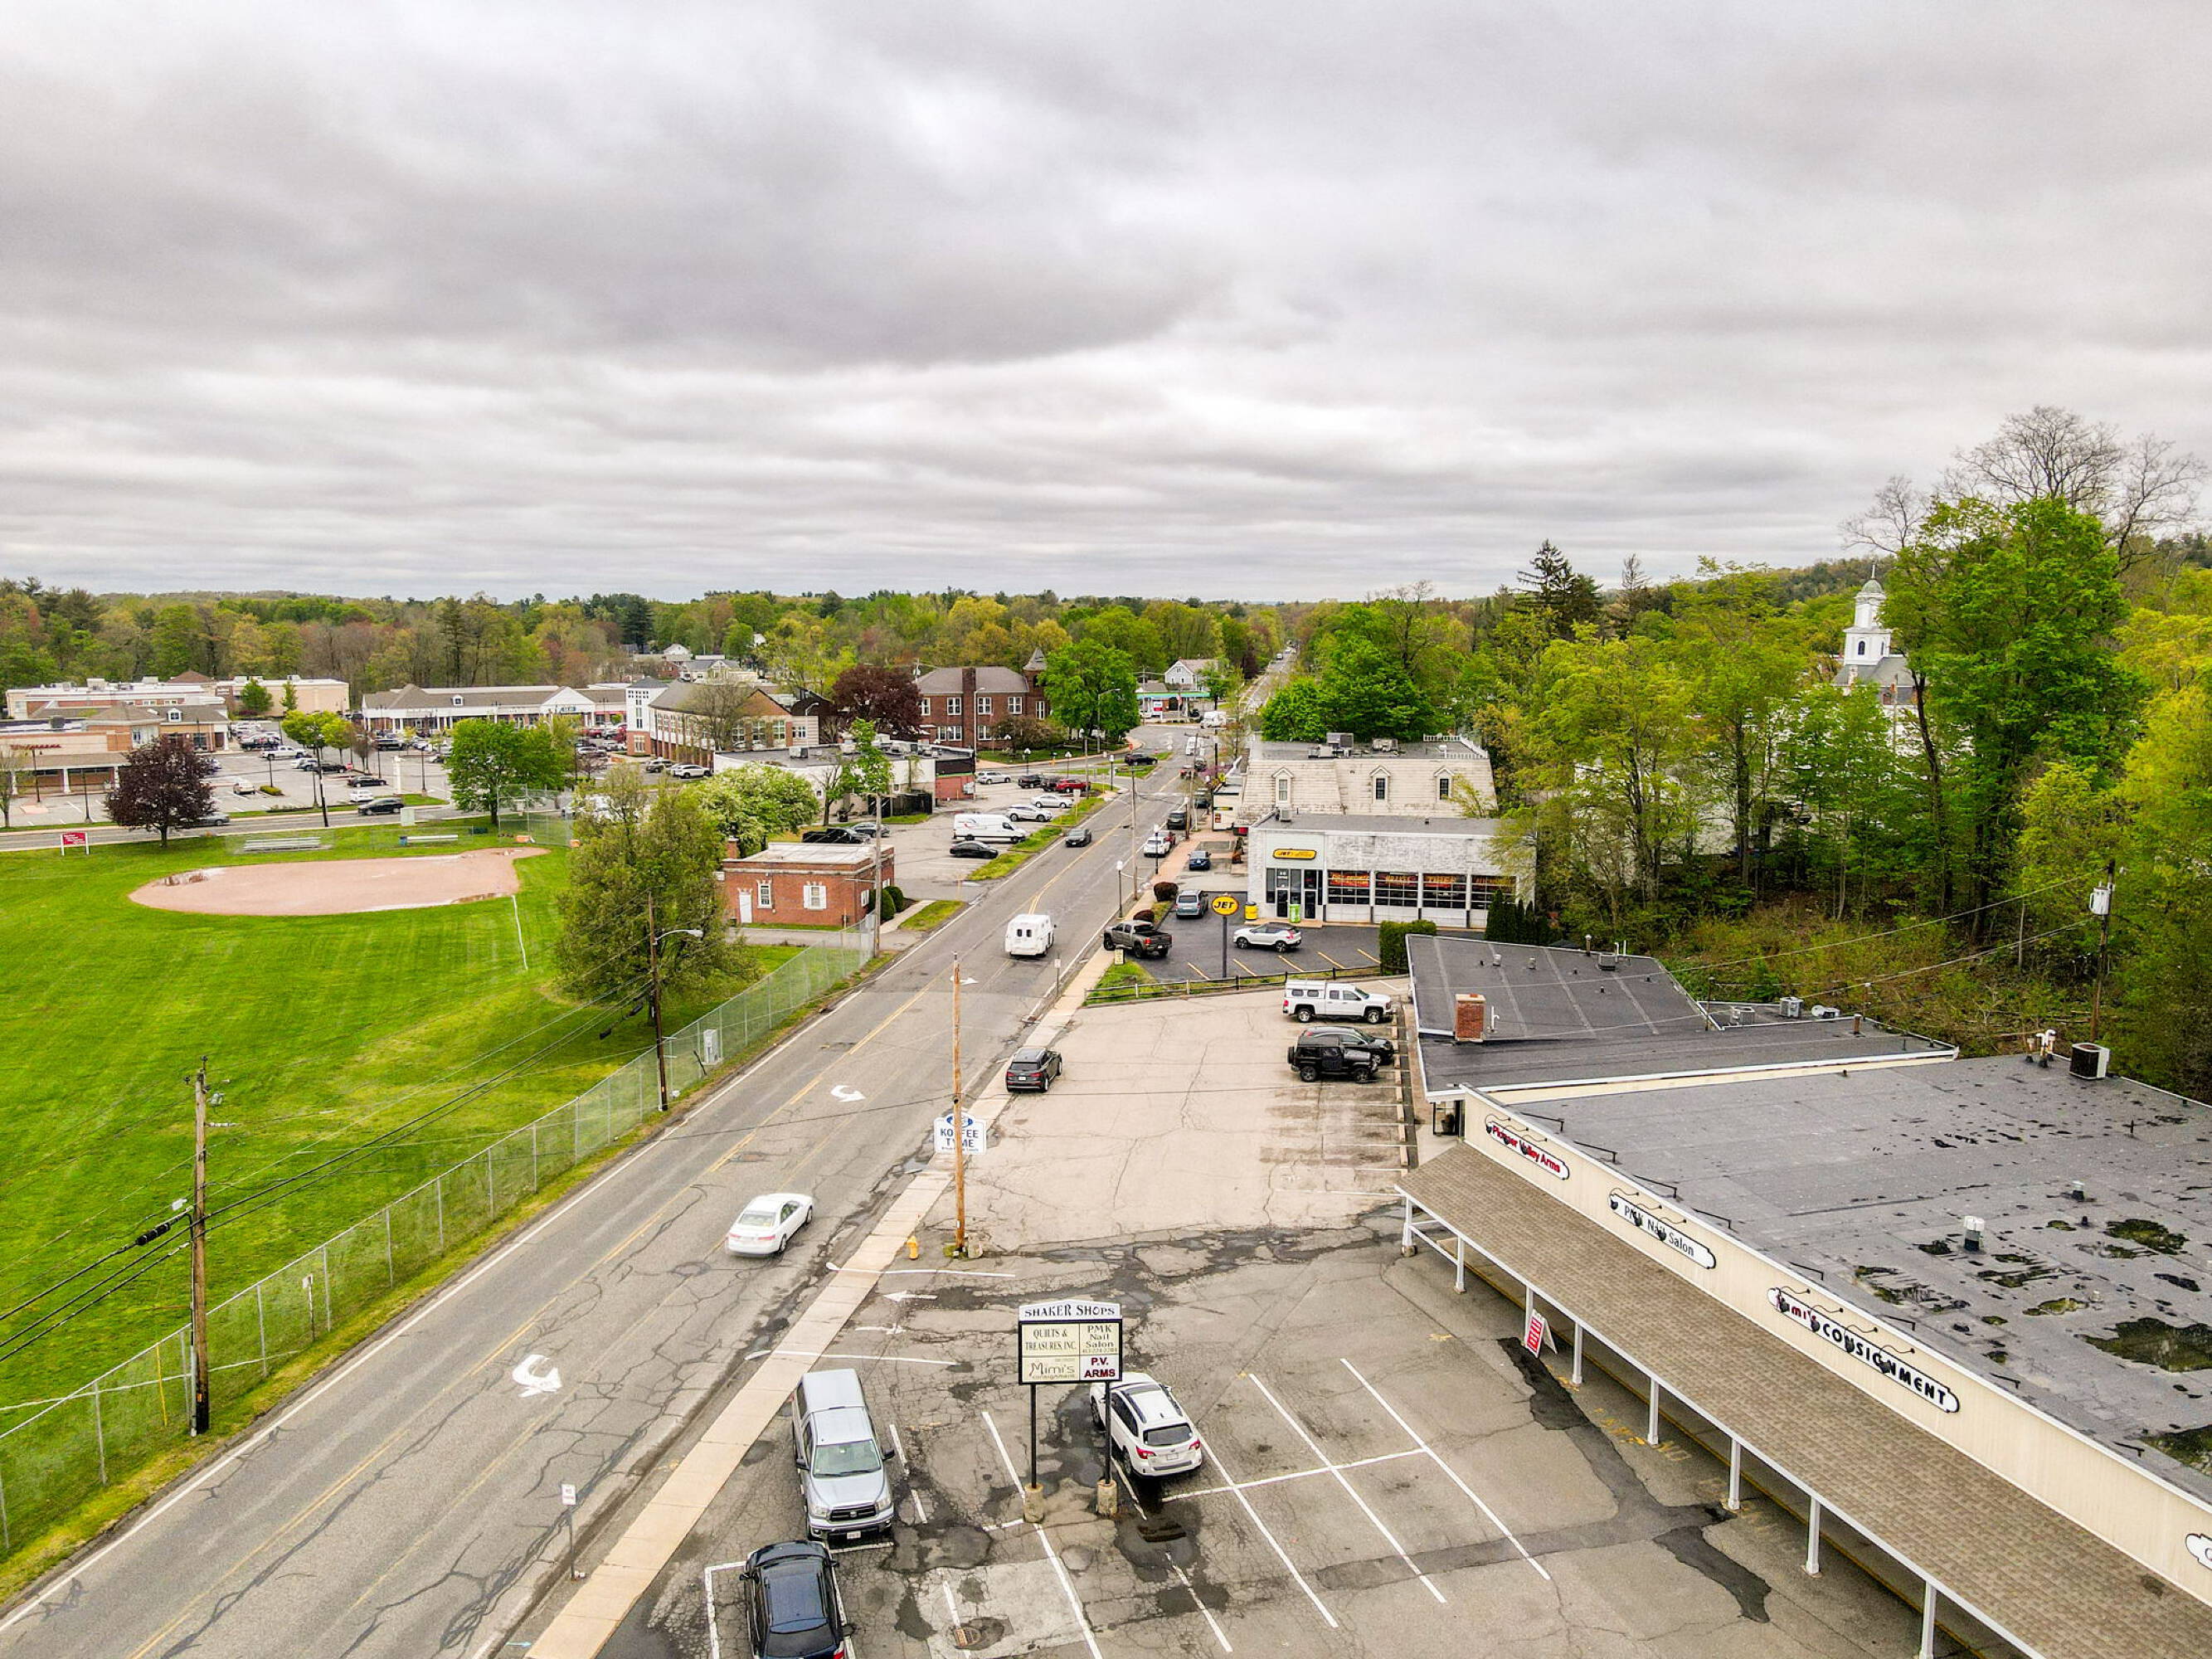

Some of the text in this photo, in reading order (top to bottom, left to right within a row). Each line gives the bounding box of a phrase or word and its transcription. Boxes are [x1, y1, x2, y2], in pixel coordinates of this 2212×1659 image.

[1213, 901, 1234, 909] JET
[1669, 1232, 1694, 1257] Salon
[1024, 1304, 1116, 1317] SHAKER SHOPS
[1087, 1325, 1112, 1334] PMK
[1089, 1333, 1110, 1341] Nail
[1086, 1340, 1115, 1349] Salon
[1091, 1357, 1109, 1366] P.V.
[1029, 1362, 1076, 1376] Mimi's
[1083, 1369, 1116, 1378] ARMS
